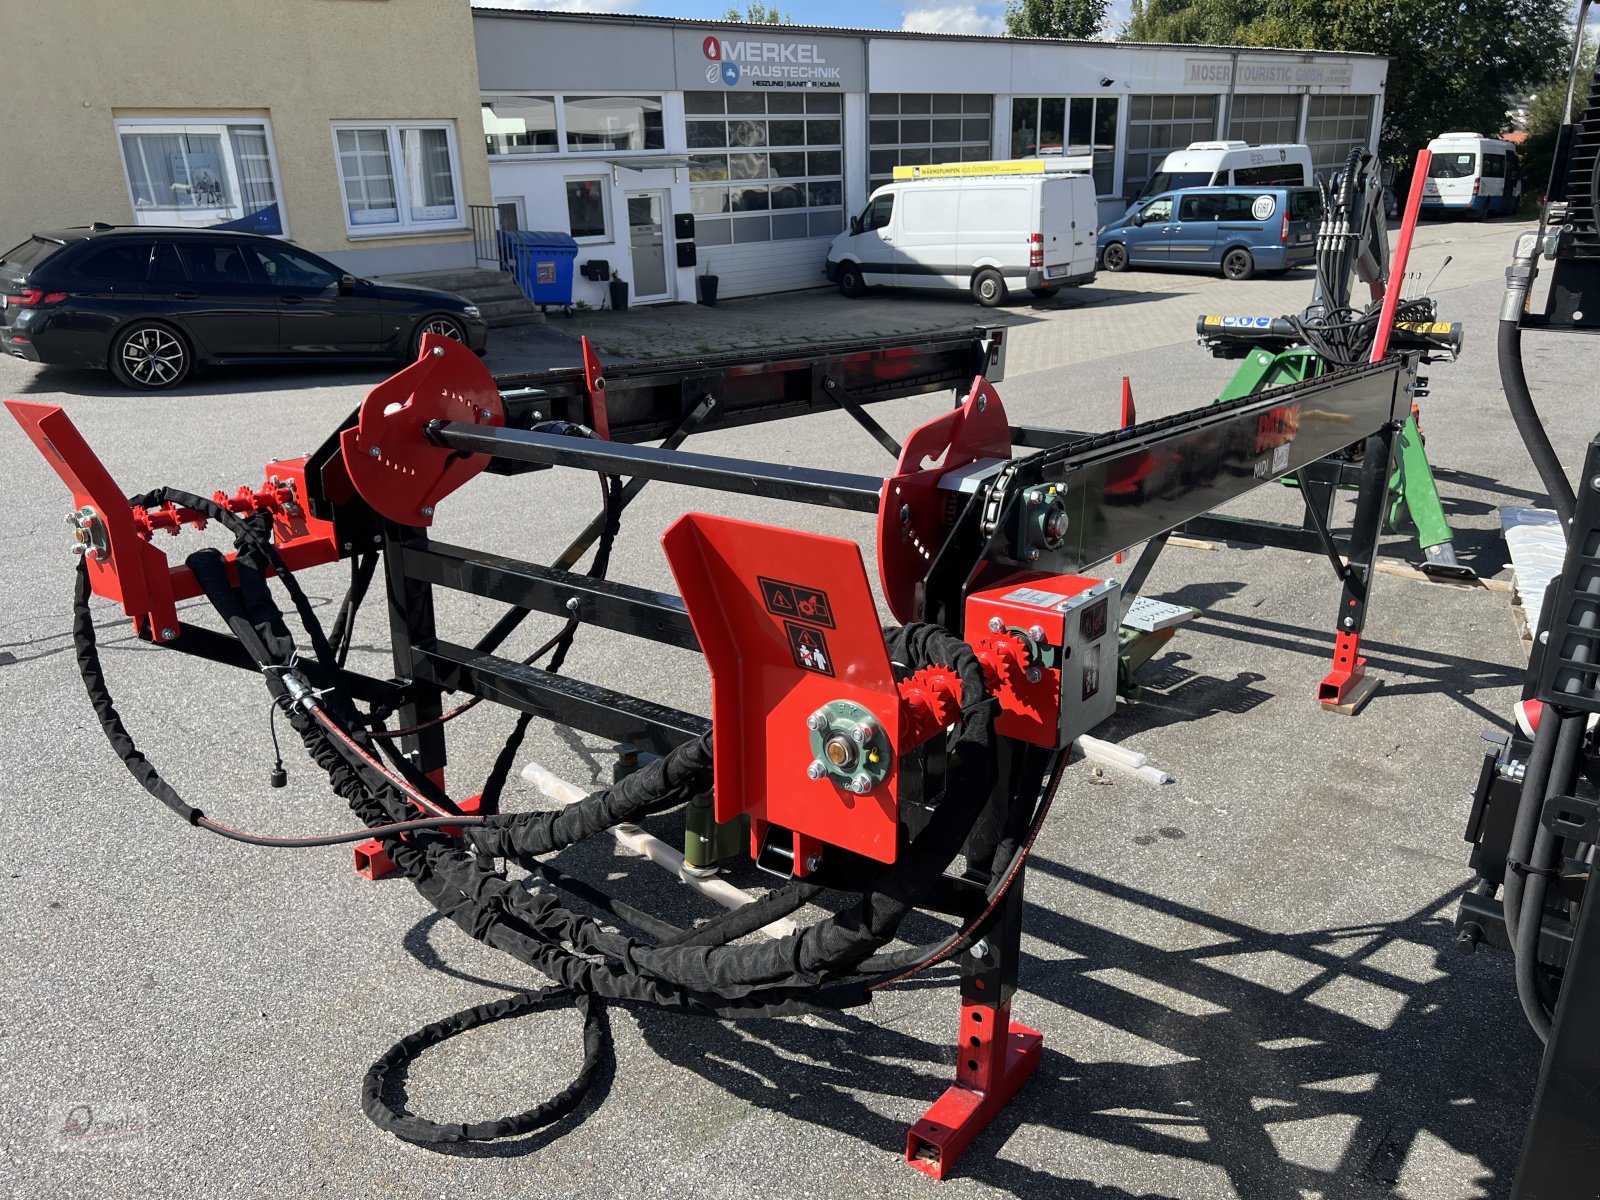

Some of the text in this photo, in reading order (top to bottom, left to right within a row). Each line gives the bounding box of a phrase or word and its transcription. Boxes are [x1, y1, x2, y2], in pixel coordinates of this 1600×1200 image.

[721, 40, 826, 64] MERKEL
[739, 64, 841, 79] HAUSTECHNIK
[1191, 64, 1232, 81] MOSER
[1238, 65, 1292, 82] TOURISTIC
[1257, 202, 1270, 214] FIAT
[1253, 459, 1269, 479] MIDI
